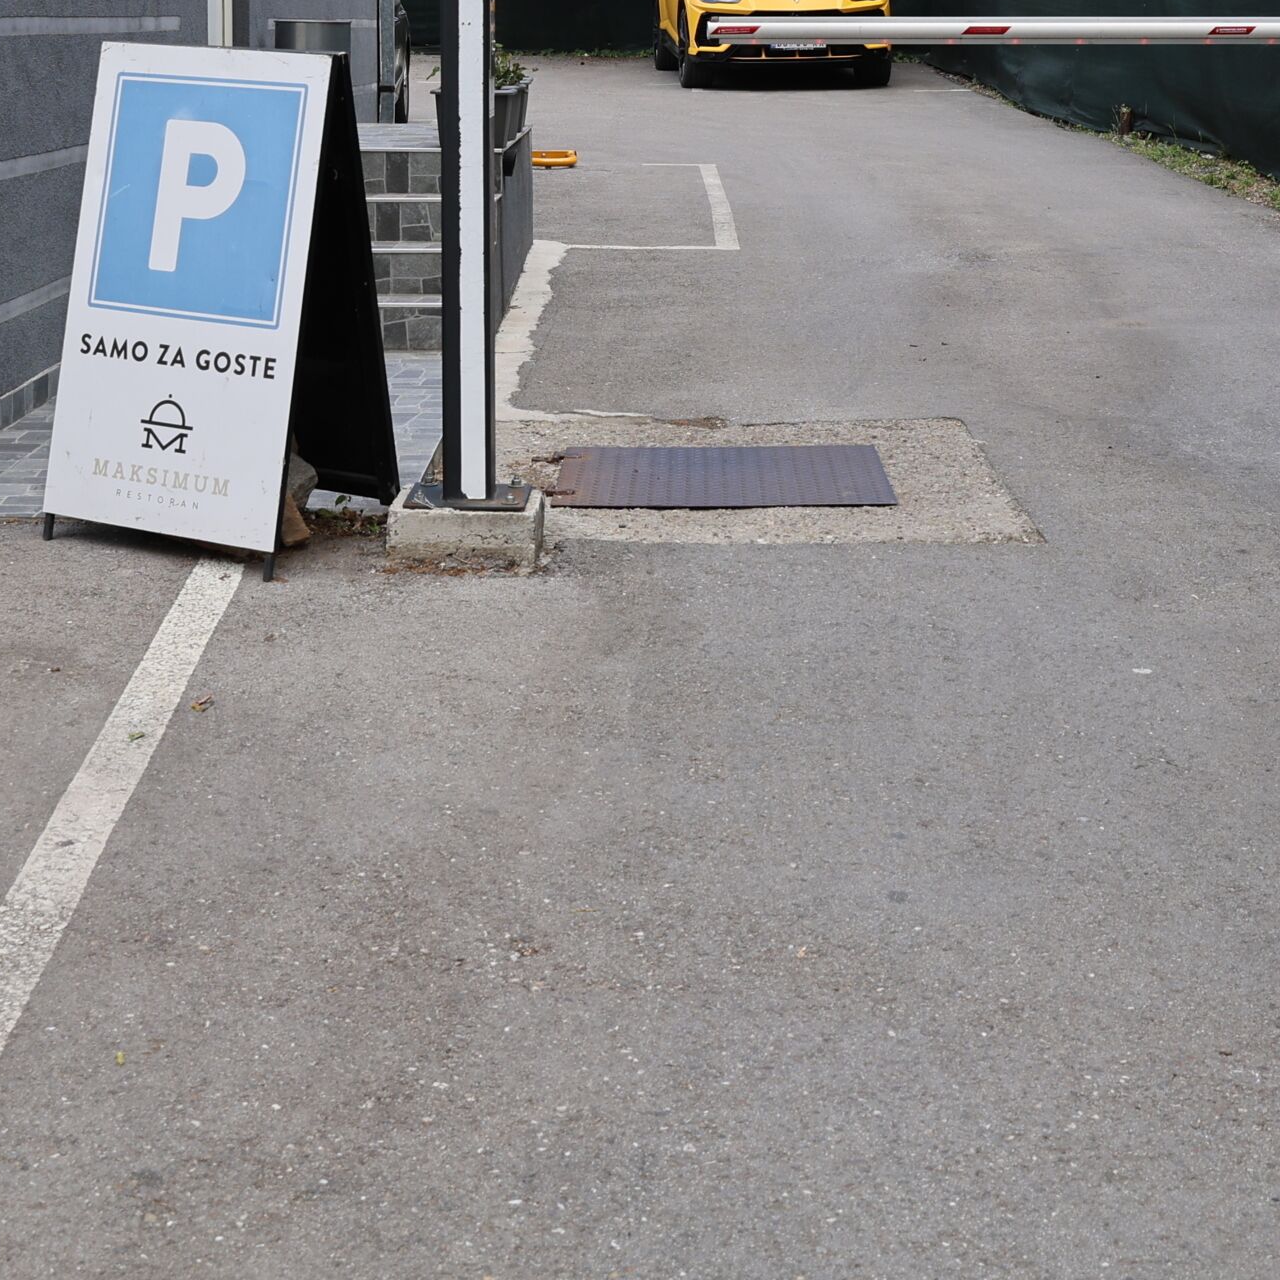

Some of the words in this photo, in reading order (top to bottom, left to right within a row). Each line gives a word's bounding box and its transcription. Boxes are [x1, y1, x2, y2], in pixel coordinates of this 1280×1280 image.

[148, 118, 247, 272] P
[80, 333, 149, 362] SAMO
[156, 343, 186, 368] ZA
[195, 349, 277, 380] GOSTE
[92, 457, 231, 497] MAKSIMUM
[115, 488, 199, 510] RESTORAN
